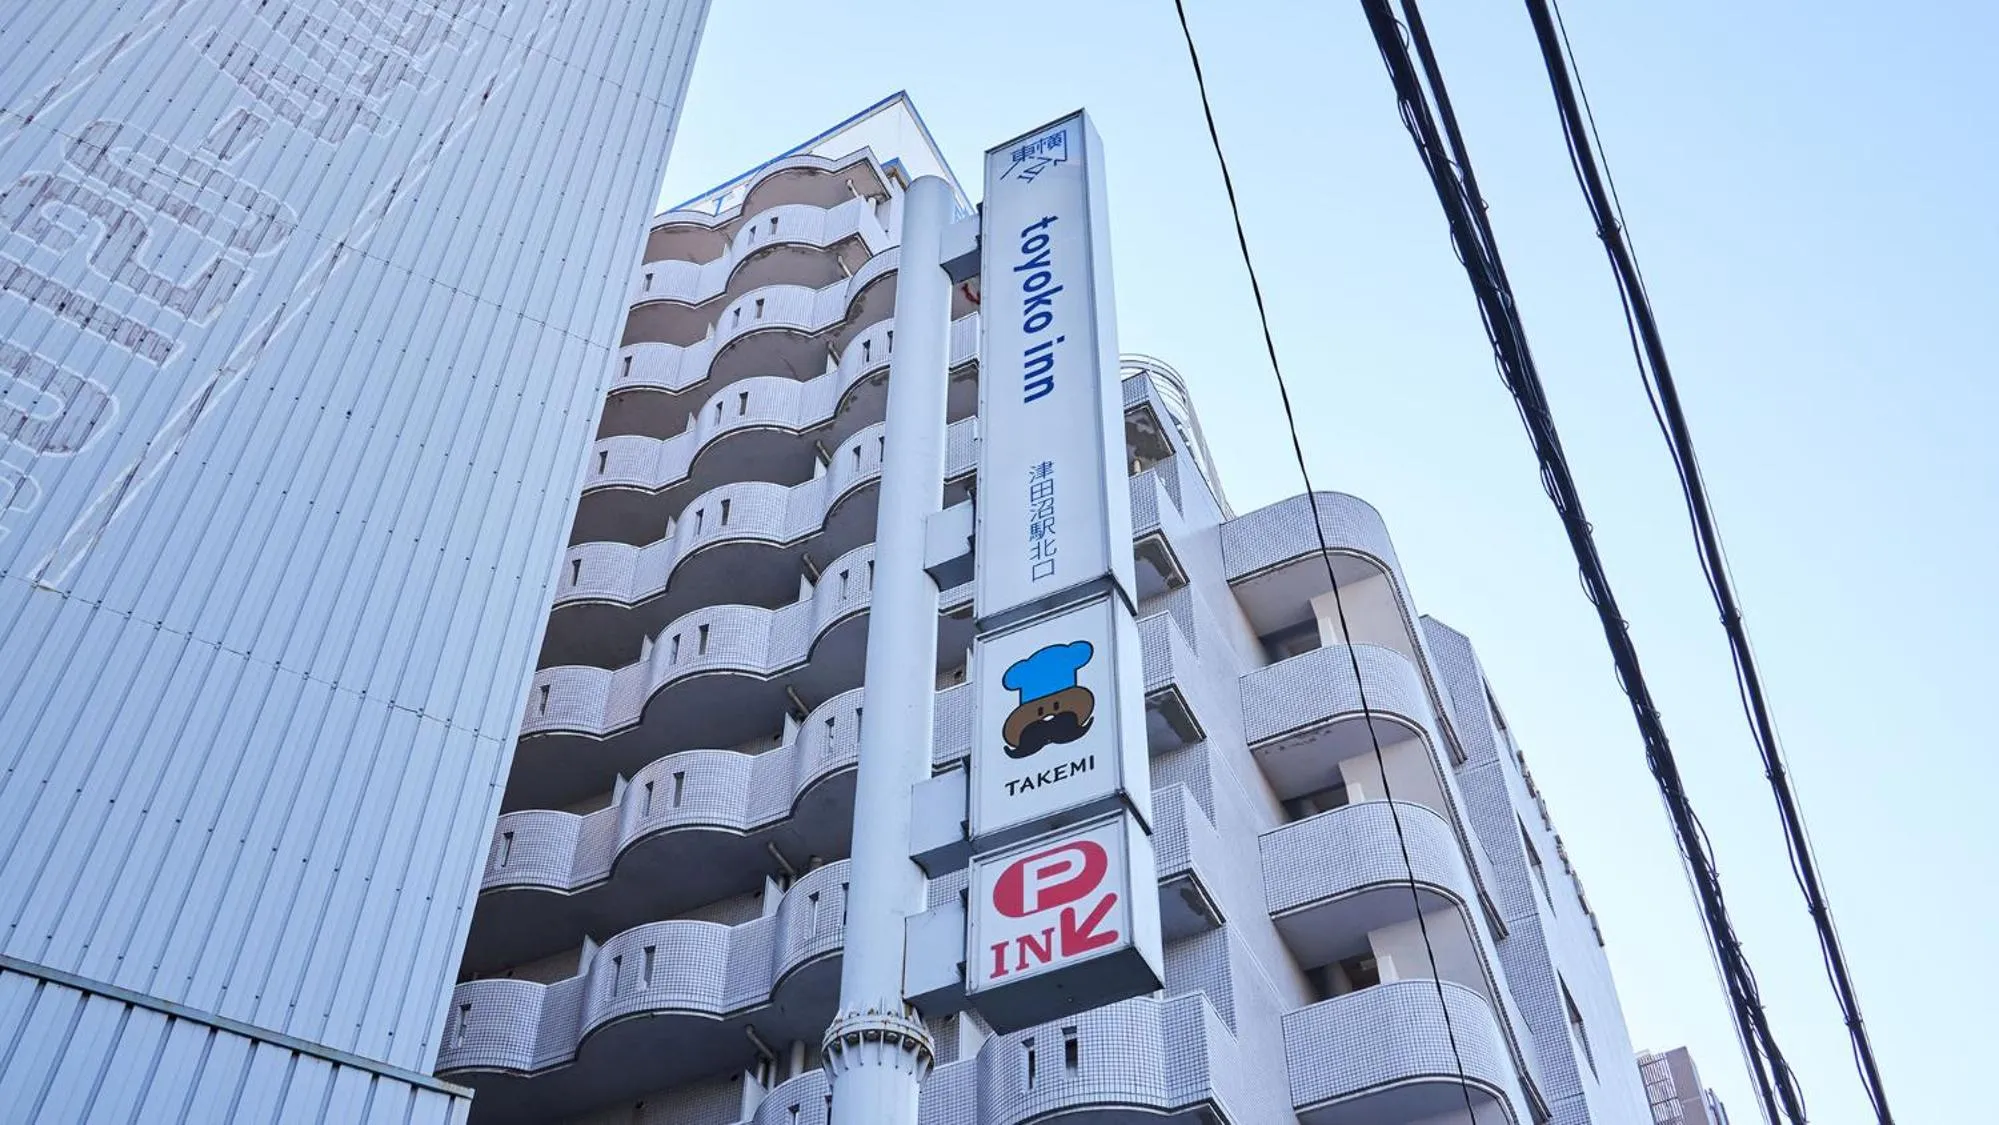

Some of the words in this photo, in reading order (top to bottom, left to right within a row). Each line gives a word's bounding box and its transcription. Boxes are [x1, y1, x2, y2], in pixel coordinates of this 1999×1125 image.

[1013, 215, 1064, 334] toyoko
[1023, 335, 1066, 404] inn
[1028, 460, 1057, 583] 津田沼駅北口
[1004, 754, 1095, 797] TAKEMI
[1022, 848, 1087, 914] P
[989, 926, 1055, 980] IN
